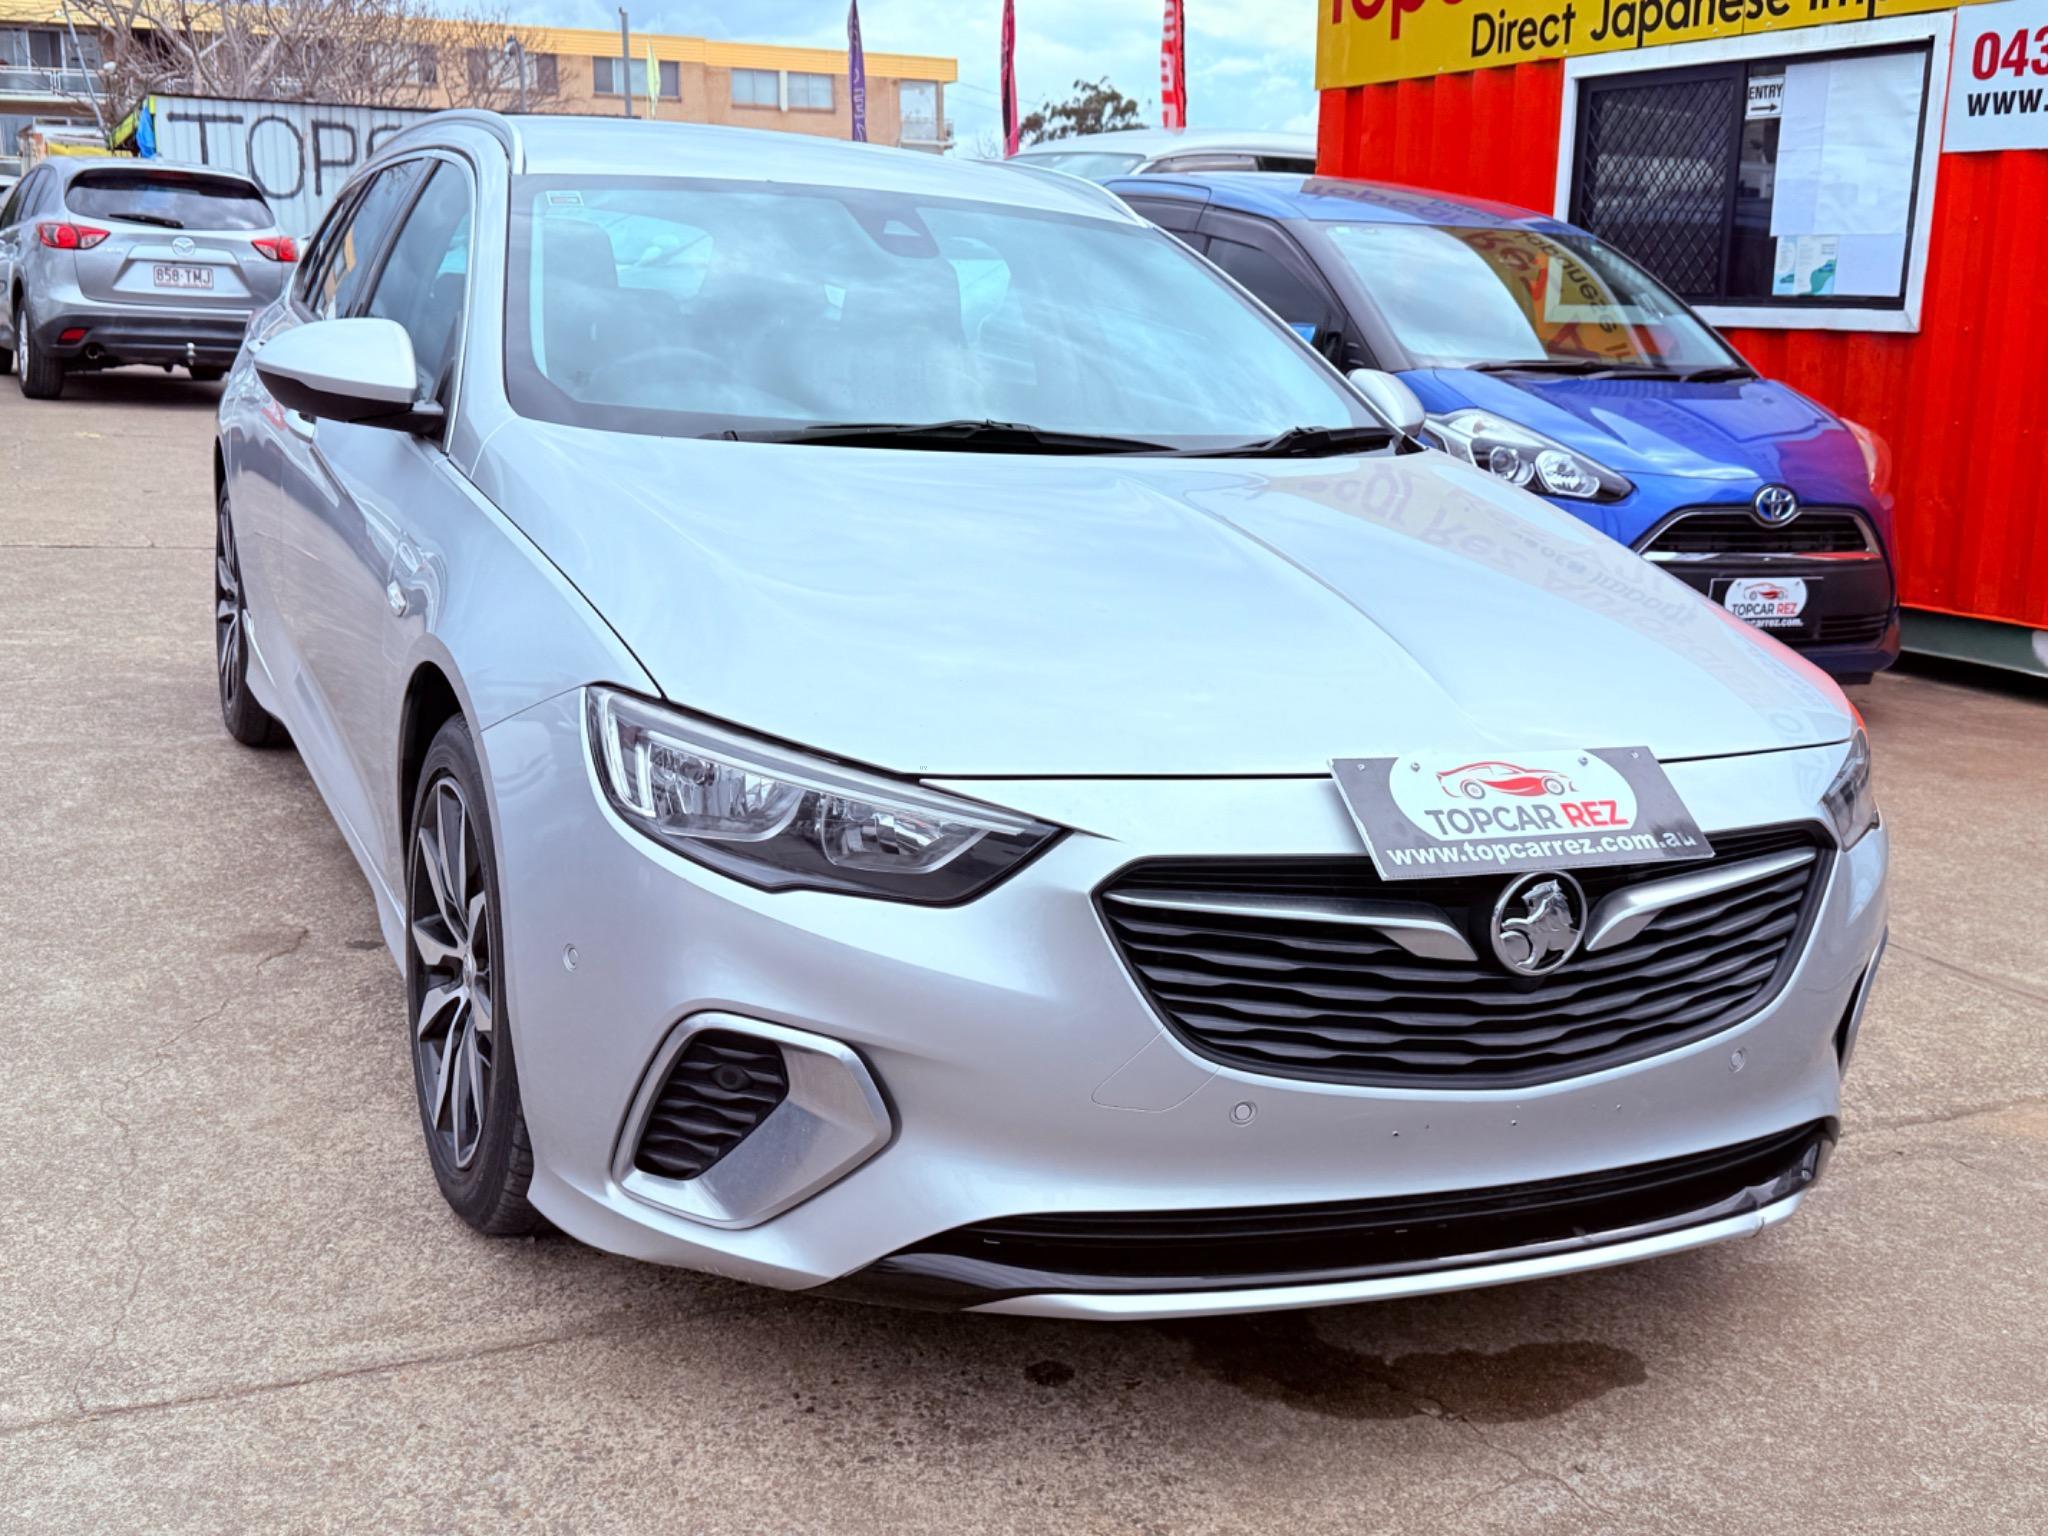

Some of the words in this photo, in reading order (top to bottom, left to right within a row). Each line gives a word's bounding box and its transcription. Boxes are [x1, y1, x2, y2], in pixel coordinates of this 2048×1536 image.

[1471, 3, 1576, 57] Direct
[1972, 25, 2048, 80] 043
[1749, 83, 1784, 99] ENTRY
[1732, 604, 1774, 616] TOPCAR
[1776, 603, 1797, 615] REZ
[1424, 804, 1562, 836] TOPCAR
[1560, 799, 1629, 828] REZ
[1386, 831, 1698, 865] www.topcarrez.com.au
